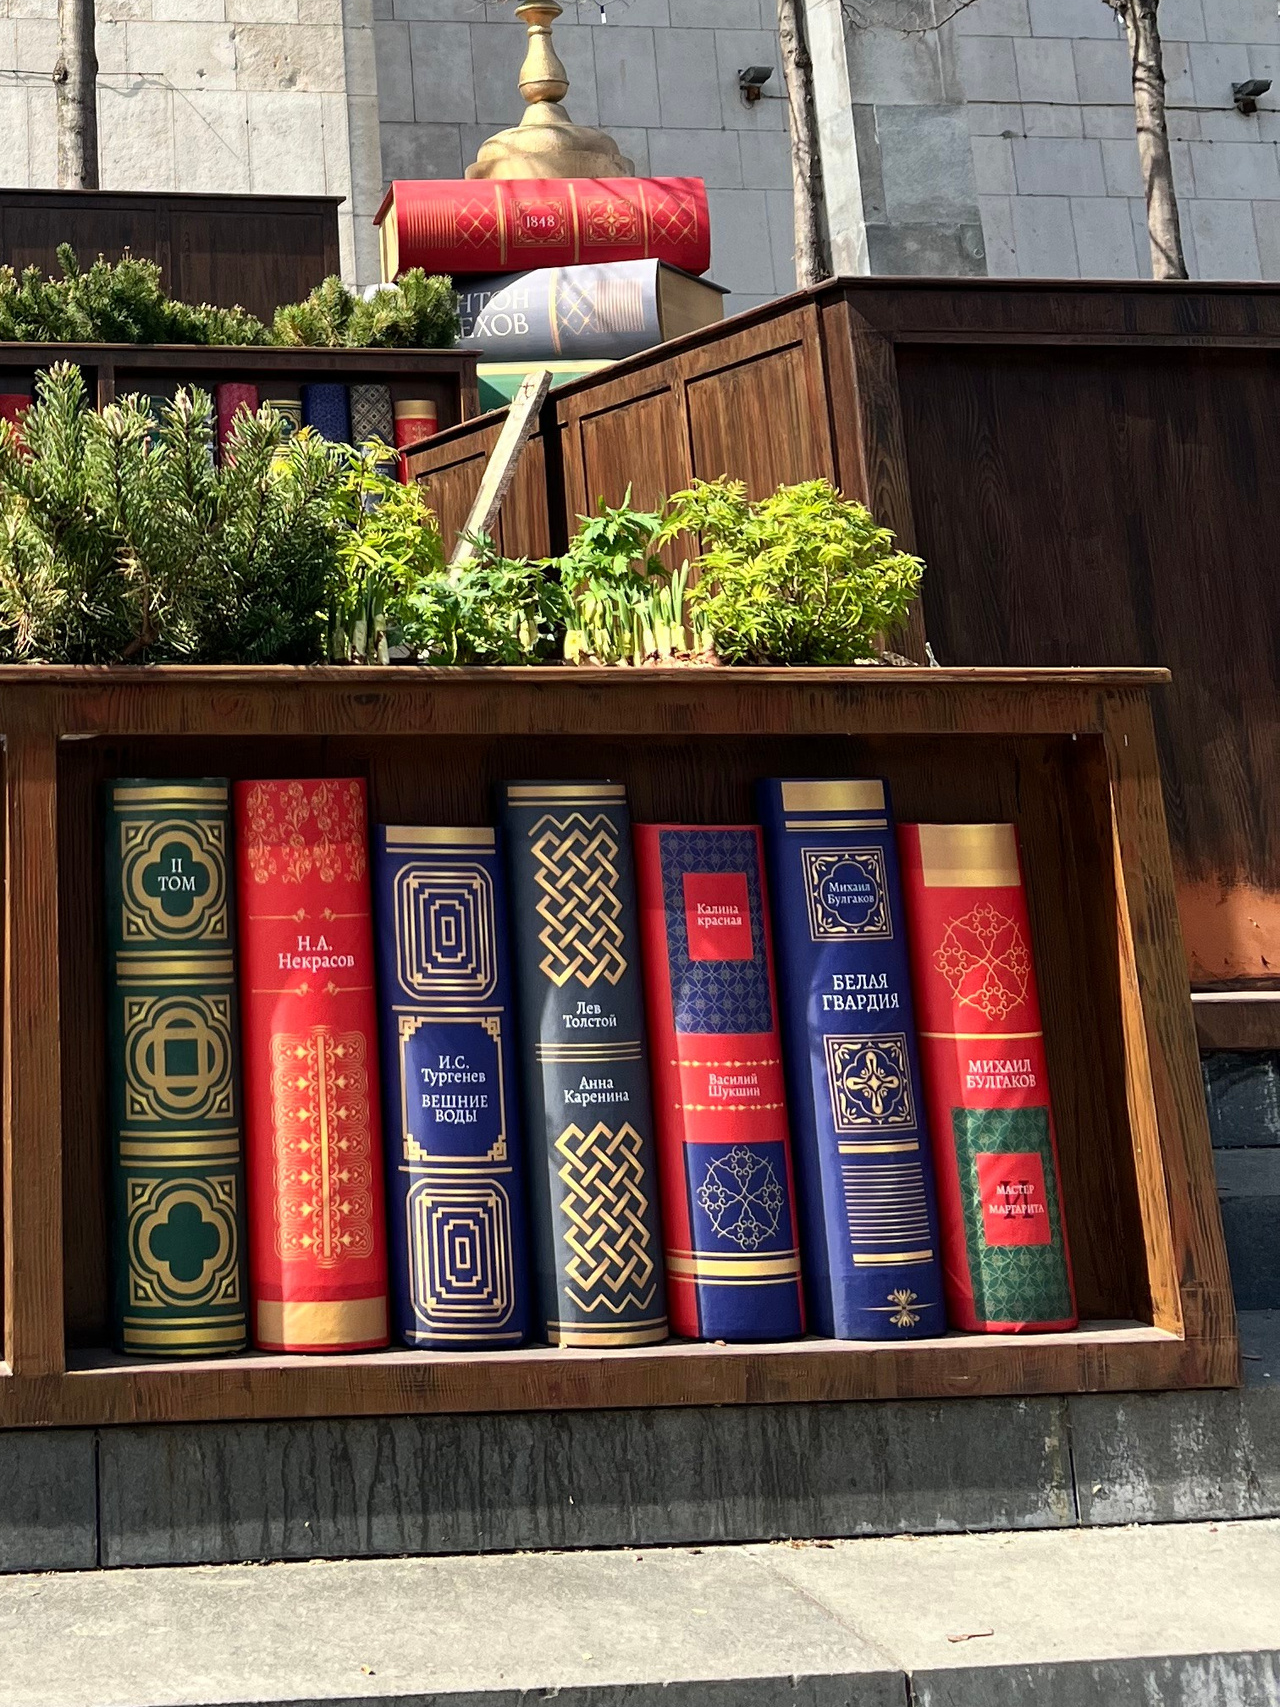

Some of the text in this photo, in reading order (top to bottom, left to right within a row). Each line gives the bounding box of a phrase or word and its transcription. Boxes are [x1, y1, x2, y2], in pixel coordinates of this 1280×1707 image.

[526, 214, 555, 228] 1848
[456, 288, 528, 314] НТОН
[460, 313, 528, 338] ЕХОВ
[158, 875, 196, 891] ТОМ
[829, 880, 870, 893] Михаил
[827, 892, 875, 906] Булгаков
[697, 904, 738, 914] Калина
[697, 915, 742, 928] красная
[297, 936, 333, 951] Н.А.
[278, 951, 354, 972] Некрасов
[833, 974, 888, 991] БЕЛАЯ
[823, 991, 899, 1011] ГВАРДИЯ
[576, 1002, 601, 1015] Лев
[563, 1013, 617, 1029] Толстой
[439, 1056, 469, 1068] И.С.
[969, 1059, 1031, 1072] МИХАИЛ
[421, 1068, 486, 1085] Тургенев
[579, 1076, 613, 1089] Анна
[709, 1073, 758, 1084] Василий
[966, 1074, 1036, 1089] БУЛГАКОВ
[564, 1088, 629, 1104] Каренина
[708, 1085, 760, 1097] Шукшин
[422, 1094, 488, 1109] ВЕШНИЕ
[435, 1108, 477, 1124] ВОДЫ
[996, 1185, 1034, 1194] МАСТЕР
[989, 1204, 1044, 1214] МАРГАРИТА
